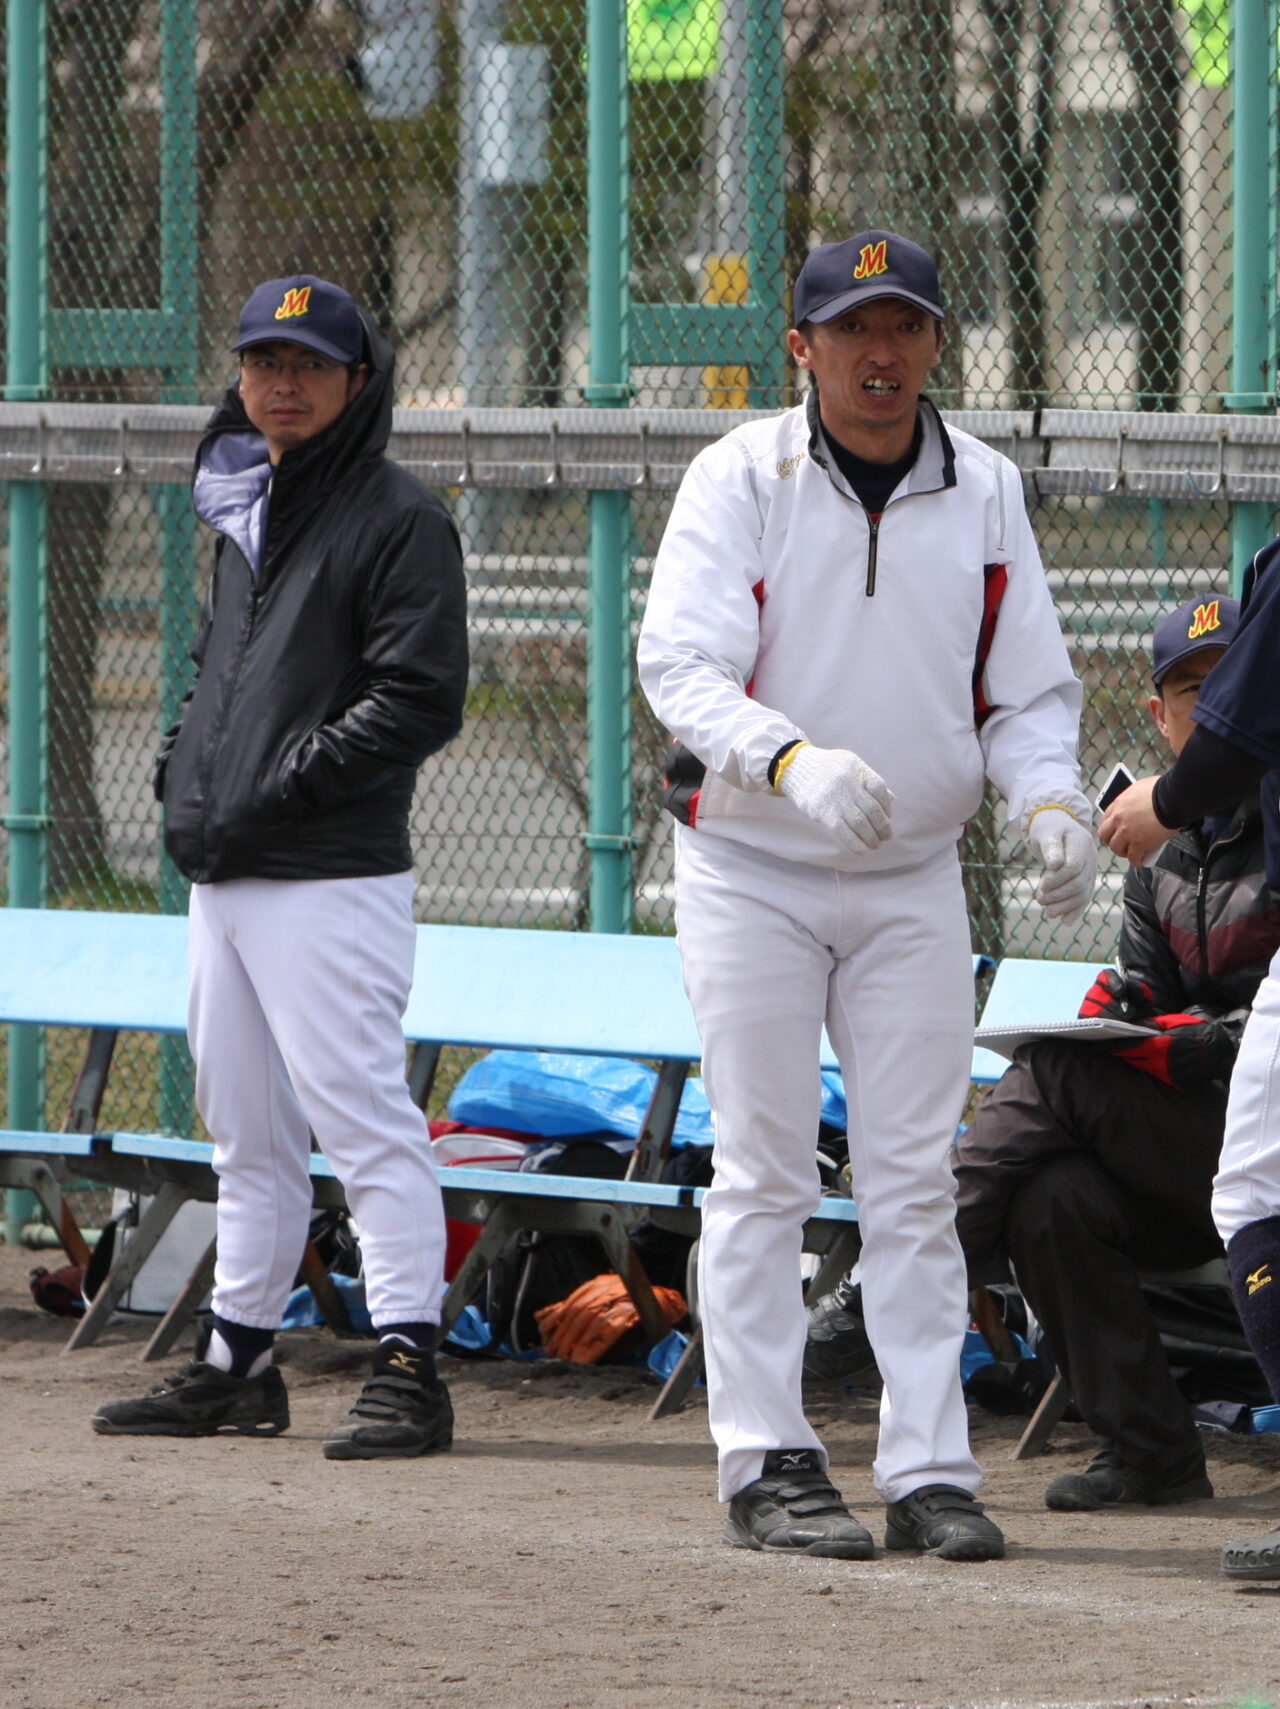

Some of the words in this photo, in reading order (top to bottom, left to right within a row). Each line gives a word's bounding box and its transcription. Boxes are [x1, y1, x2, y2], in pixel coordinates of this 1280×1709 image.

[854, 240, 888, 280] M
[275, 286, 312, 320] M
[1188, 600, 1221, 639] M
